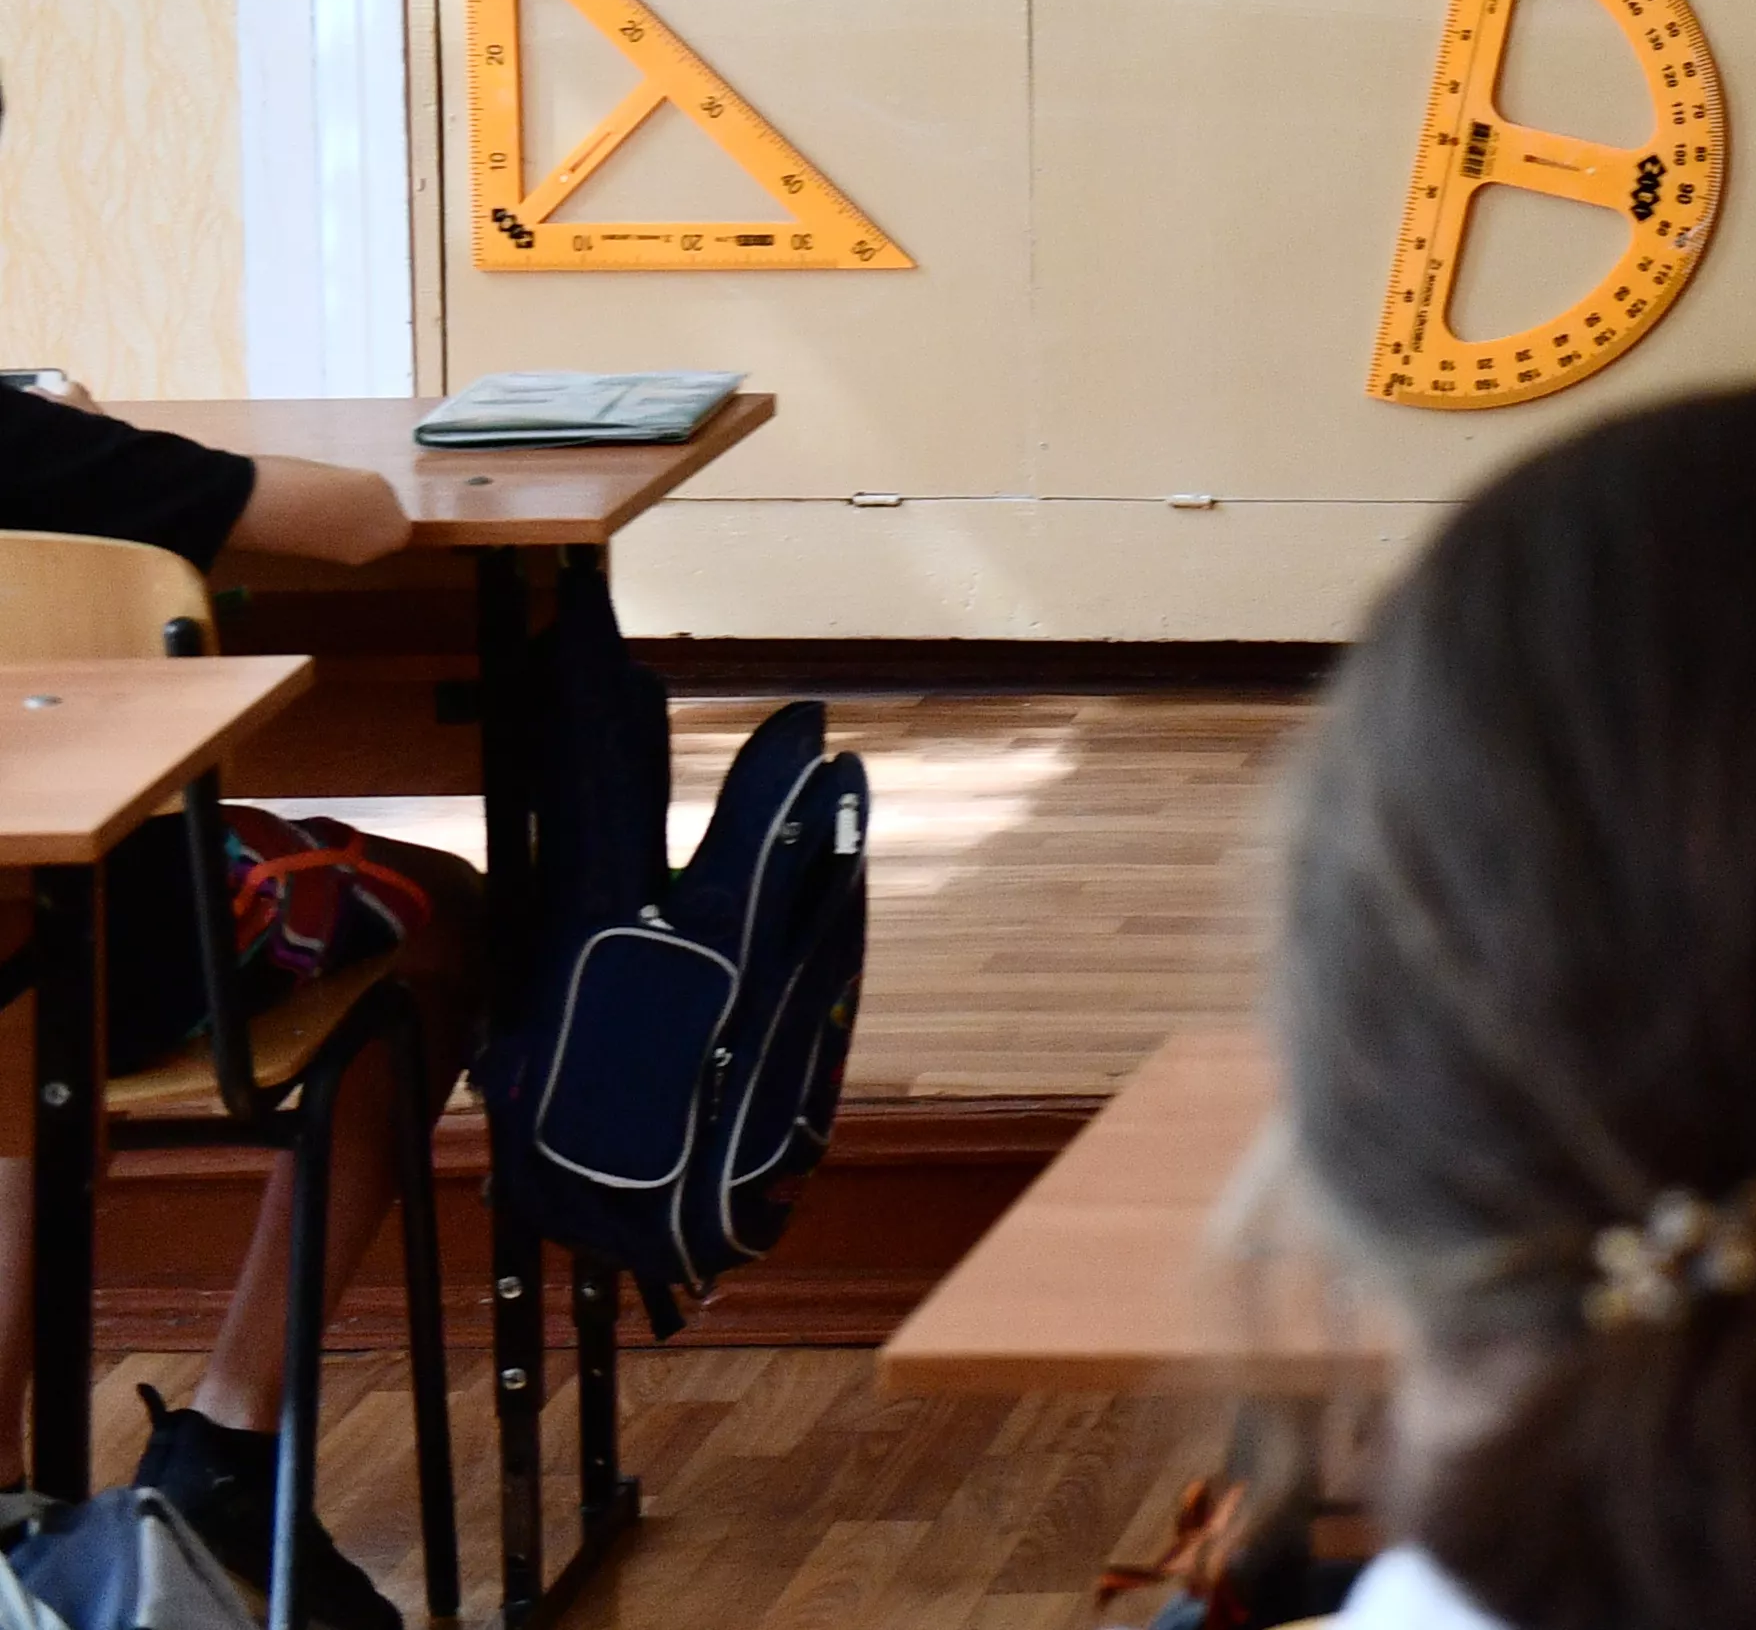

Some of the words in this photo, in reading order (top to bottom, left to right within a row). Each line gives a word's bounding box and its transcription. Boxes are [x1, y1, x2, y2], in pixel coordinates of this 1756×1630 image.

[1645, 28, 1664, 51] 130
[486, 44, 504, 66] 20
[1661, 64, 1679, 88] 120
[619, 20, 646, 44] 20
[700, 96, 725, 120] 30
[781, 172, 805, 196] 40
[1671, 101, 1687, 126] 110
[1692, 103, 1706, 120] 70
[489, 152, 507, 170] 10
[1673, 143, 1687, 167] 100
[1676, 182, 1695, 205] 90
[680, 234, 704, 251] 20
